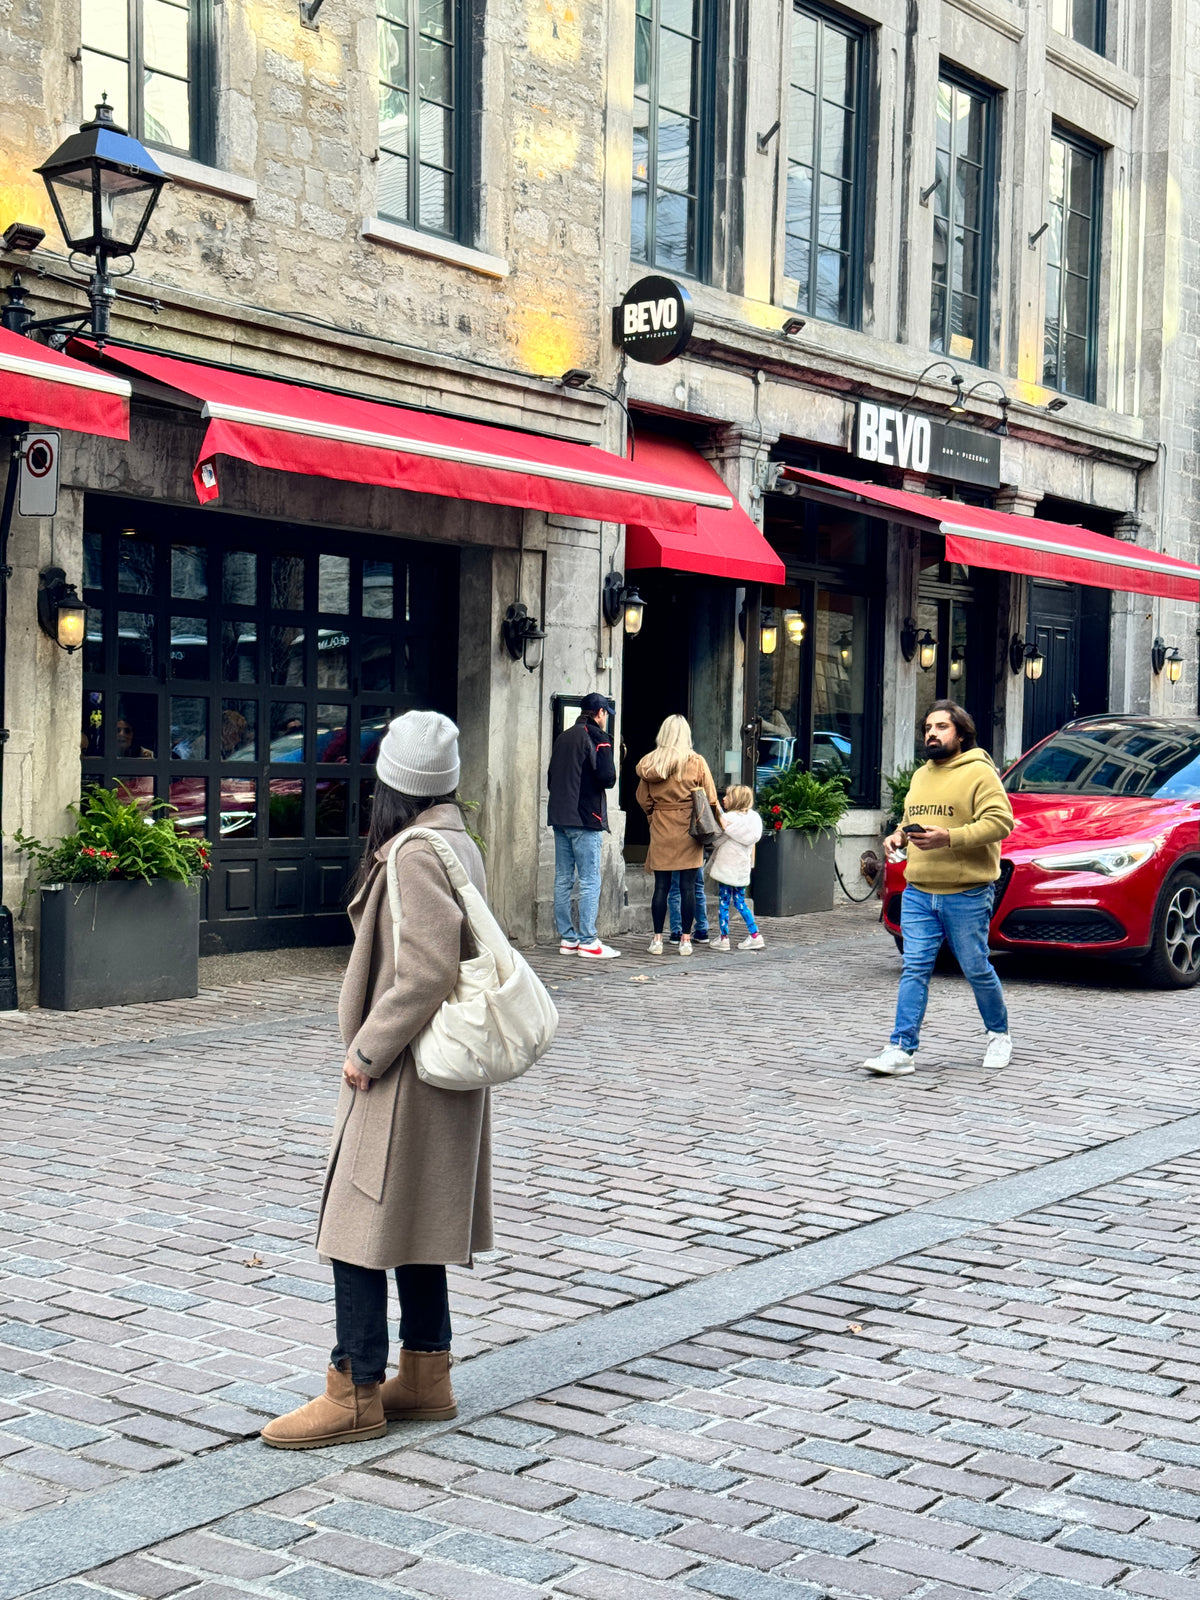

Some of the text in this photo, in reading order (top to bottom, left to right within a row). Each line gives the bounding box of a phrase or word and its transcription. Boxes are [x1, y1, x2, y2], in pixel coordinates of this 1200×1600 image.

[624, 297, 677, 334] BEVO
[646, 330, 677, 339] PIZZERIA
[859, 401, 931, 473] BEVO
[942, 447, 954, 456] BAR
[962, 451, 989, 464] PIZZERIA
[909, 804, 954, 817] ESSENTIALS
